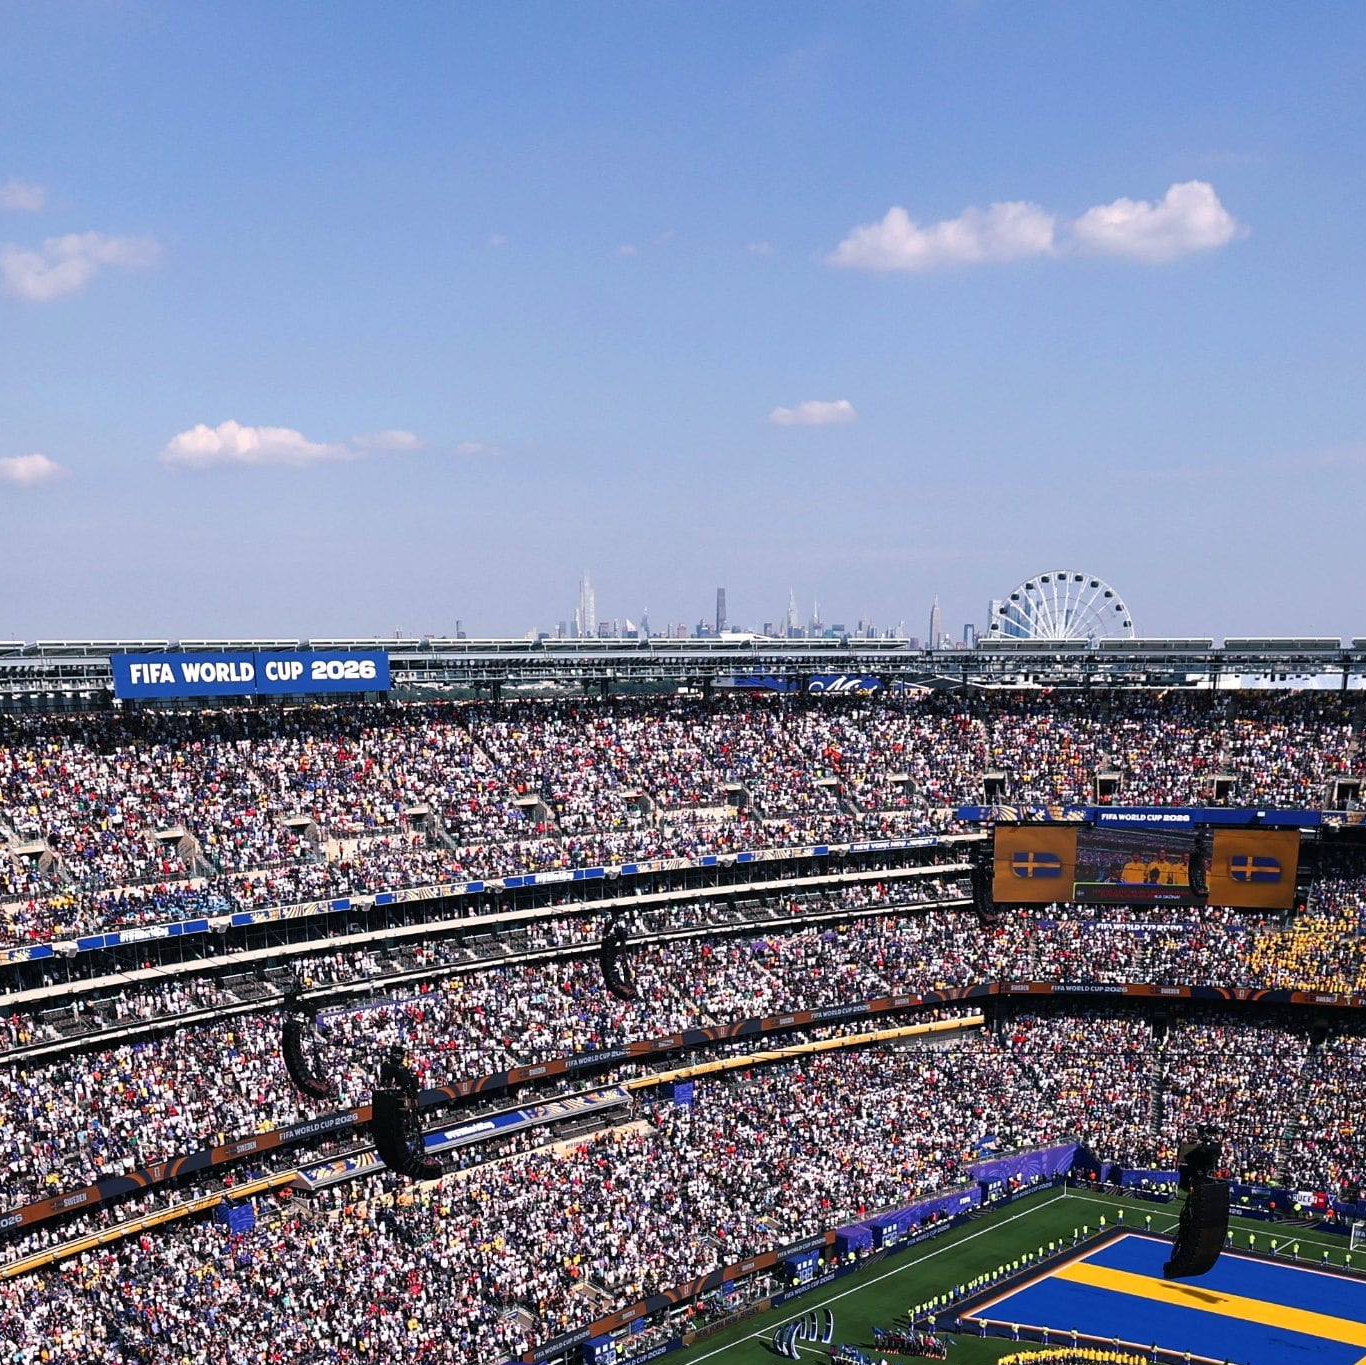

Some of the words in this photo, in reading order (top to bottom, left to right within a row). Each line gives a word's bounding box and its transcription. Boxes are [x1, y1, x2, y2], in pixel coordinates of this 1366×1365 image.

[130, 664, 175, 684] FIFA
[181, 662, 254, 683] WORLD
[265, 661, 303, 681] CUP
[311, 660, 377, 680] 2026
[565, 1057, 578, 1069] FIFA
[578, 1053, 599, 1066] WORLD
[599, 1051, 611, 1061] CUP
[278, 1128, 296, 1141] FIFA
[296, 1122, 320, 1137] WORLD
[319, 1119, 334, 1133] CUP
[334, 1113, 358, 1129] 2026
[63, 1192, 87, 1207] SWEDEN
[533, 1349, 545, 1360] FIFA
[545, 1342, 564, 1356] WORLD
[563, 1338, 574, 1348] CUP
[635, 1355, 647, 1365] CUP
[647, 1346, 667, 1359] 2026
